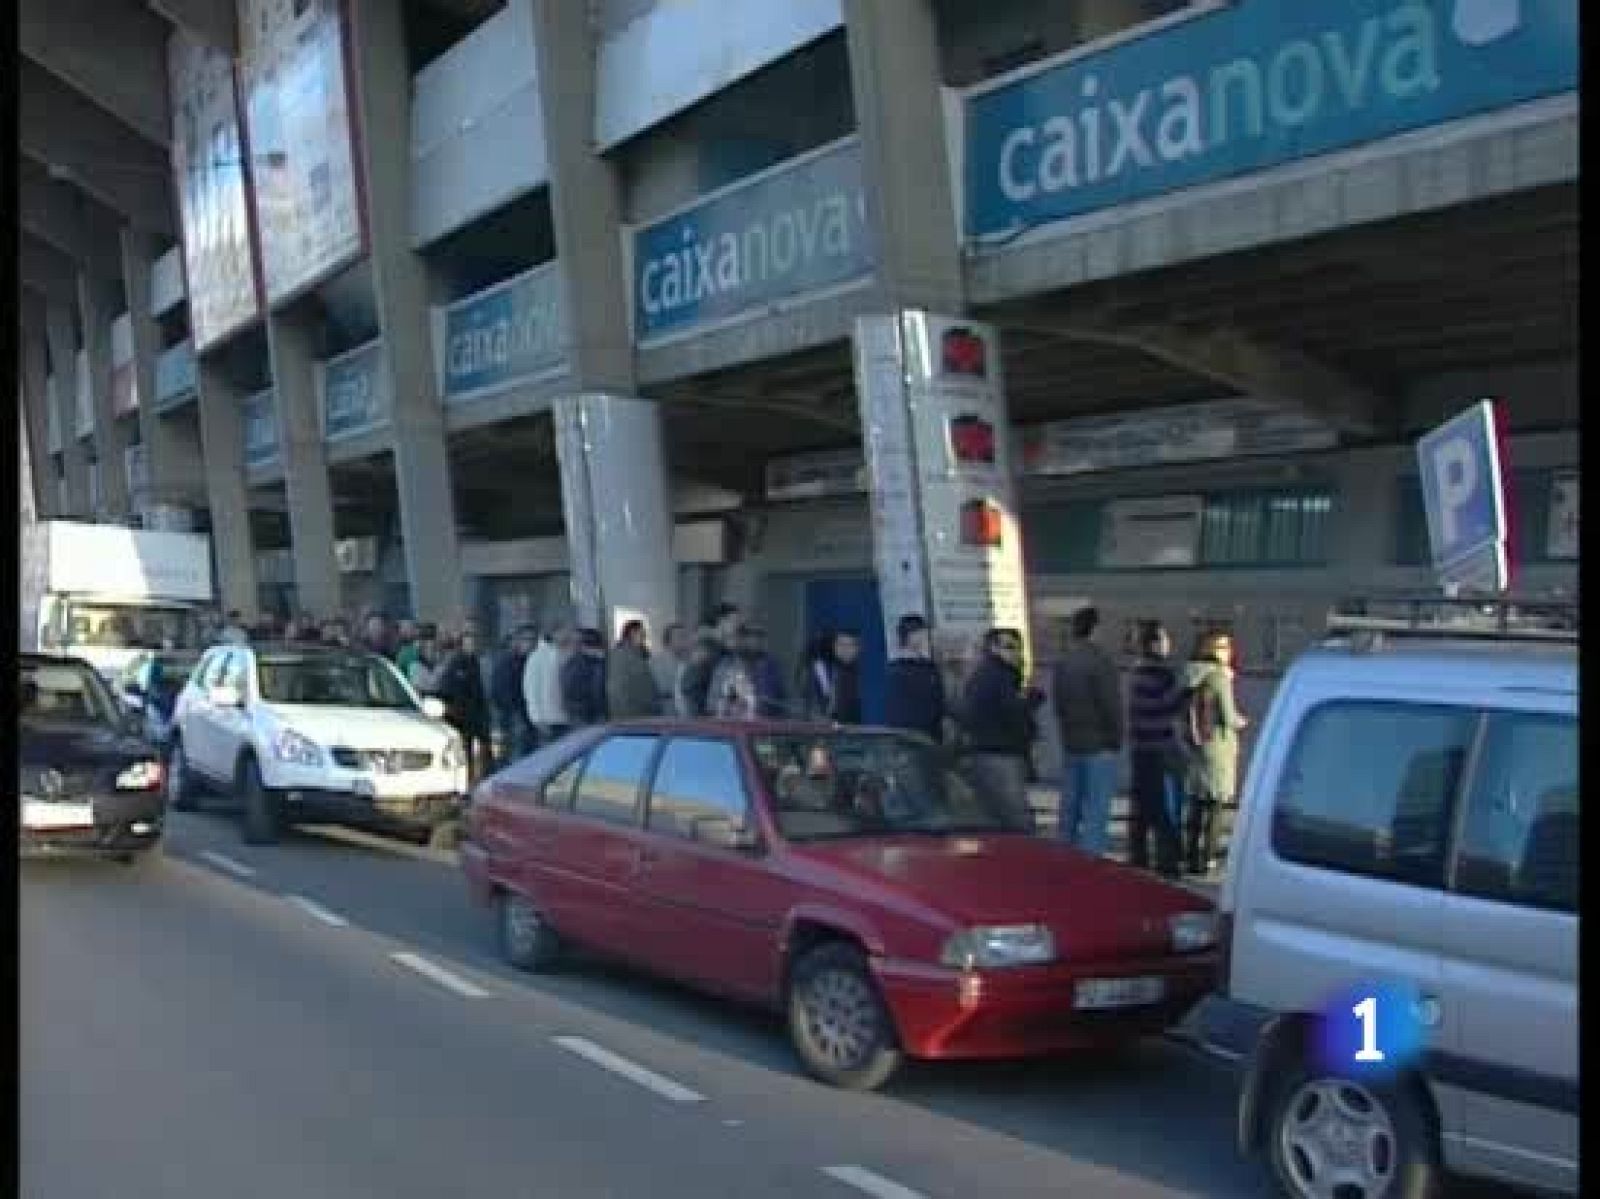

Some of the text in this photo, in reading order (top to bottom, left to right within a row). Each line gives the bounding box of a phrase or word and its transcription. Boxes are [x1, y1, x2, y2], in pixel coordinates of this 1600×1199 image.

[999, 0, 1442, 202] caixanova
[642, 192, 848, 314] caixanova
[1433, 438, 1478, 546] P
